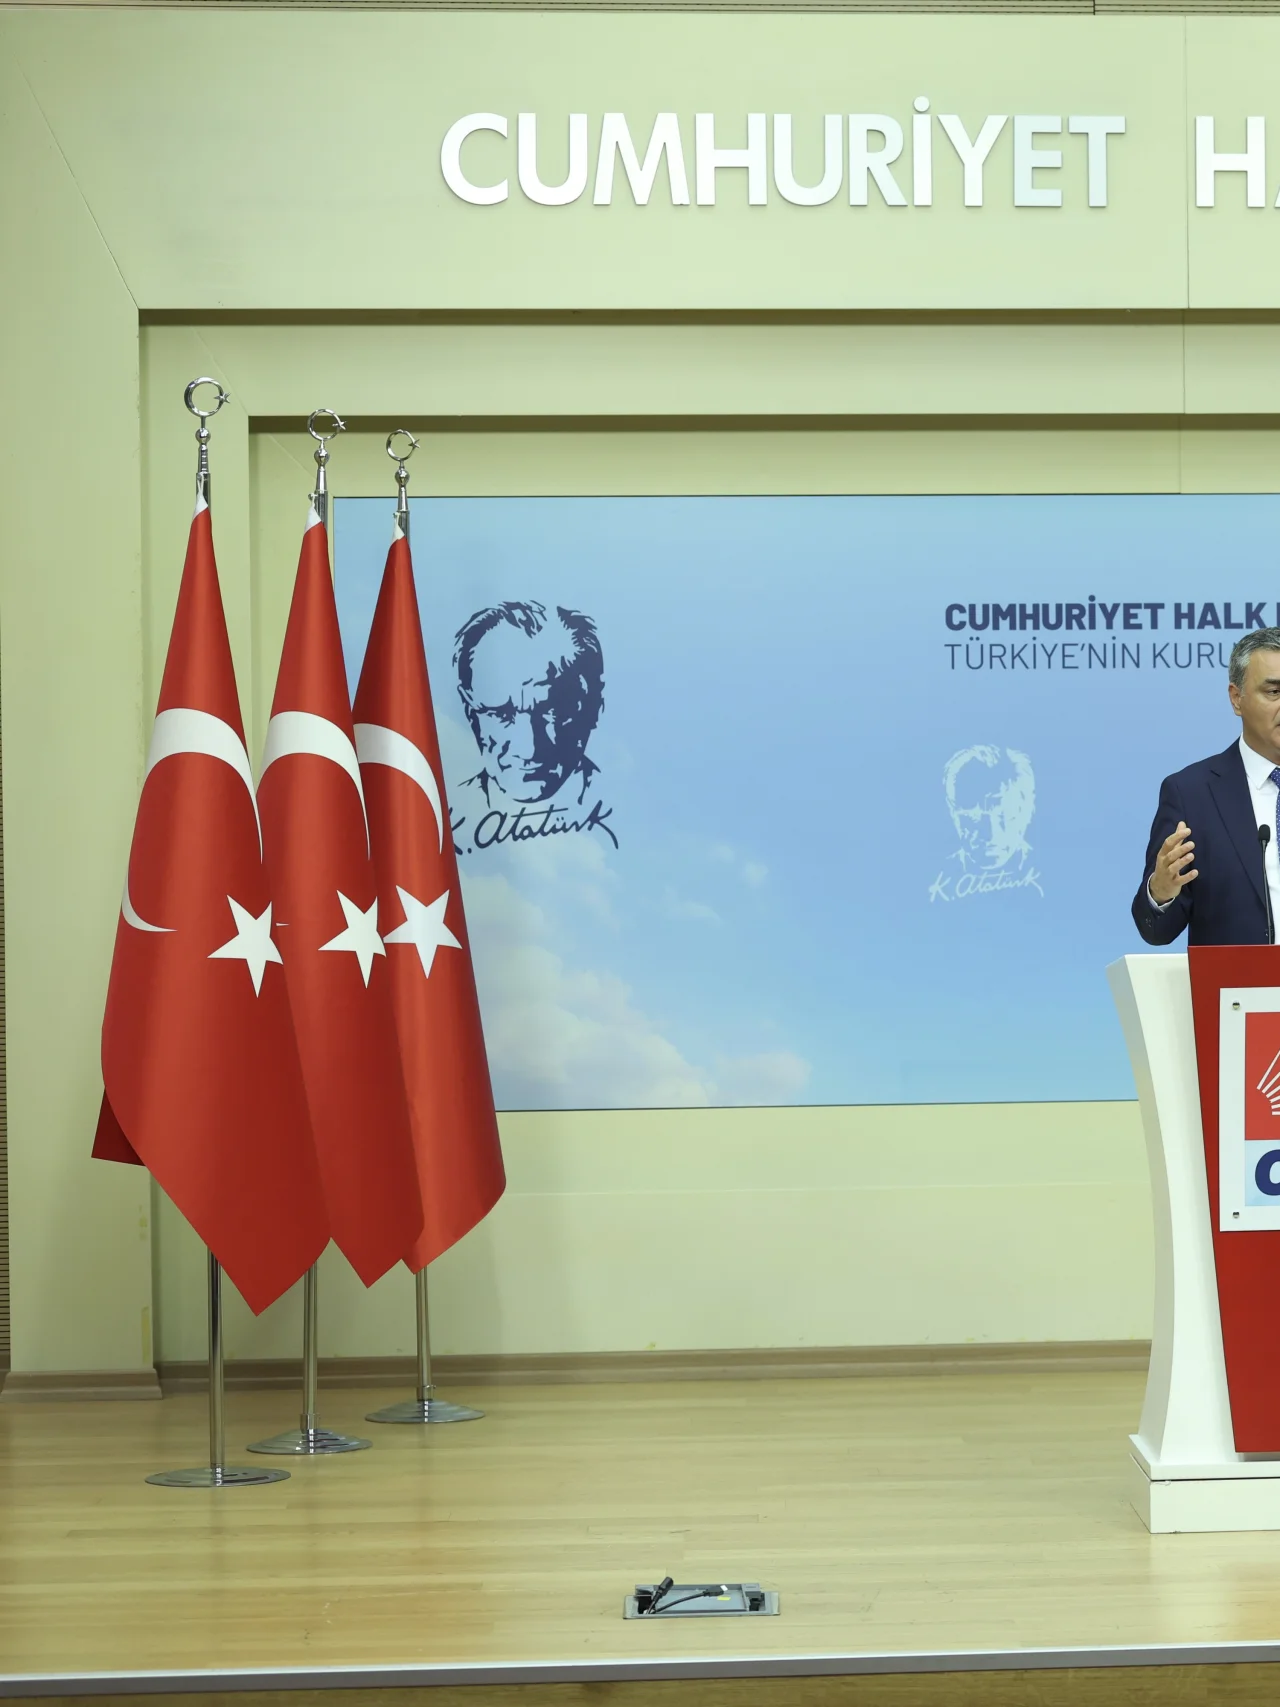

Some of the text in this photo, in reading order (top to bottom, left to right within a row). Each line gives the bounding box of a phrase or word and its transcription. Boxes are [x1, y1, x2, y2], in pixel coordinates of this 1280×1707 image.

[440, 96, 1126, 207] CUMHURİYET
[944, 594, 1166, 632] CUMHURİYET
[1174, 602, 1268, 630] HALK
[944, 635, 1141, 670] TÜRKİYE'NİN
